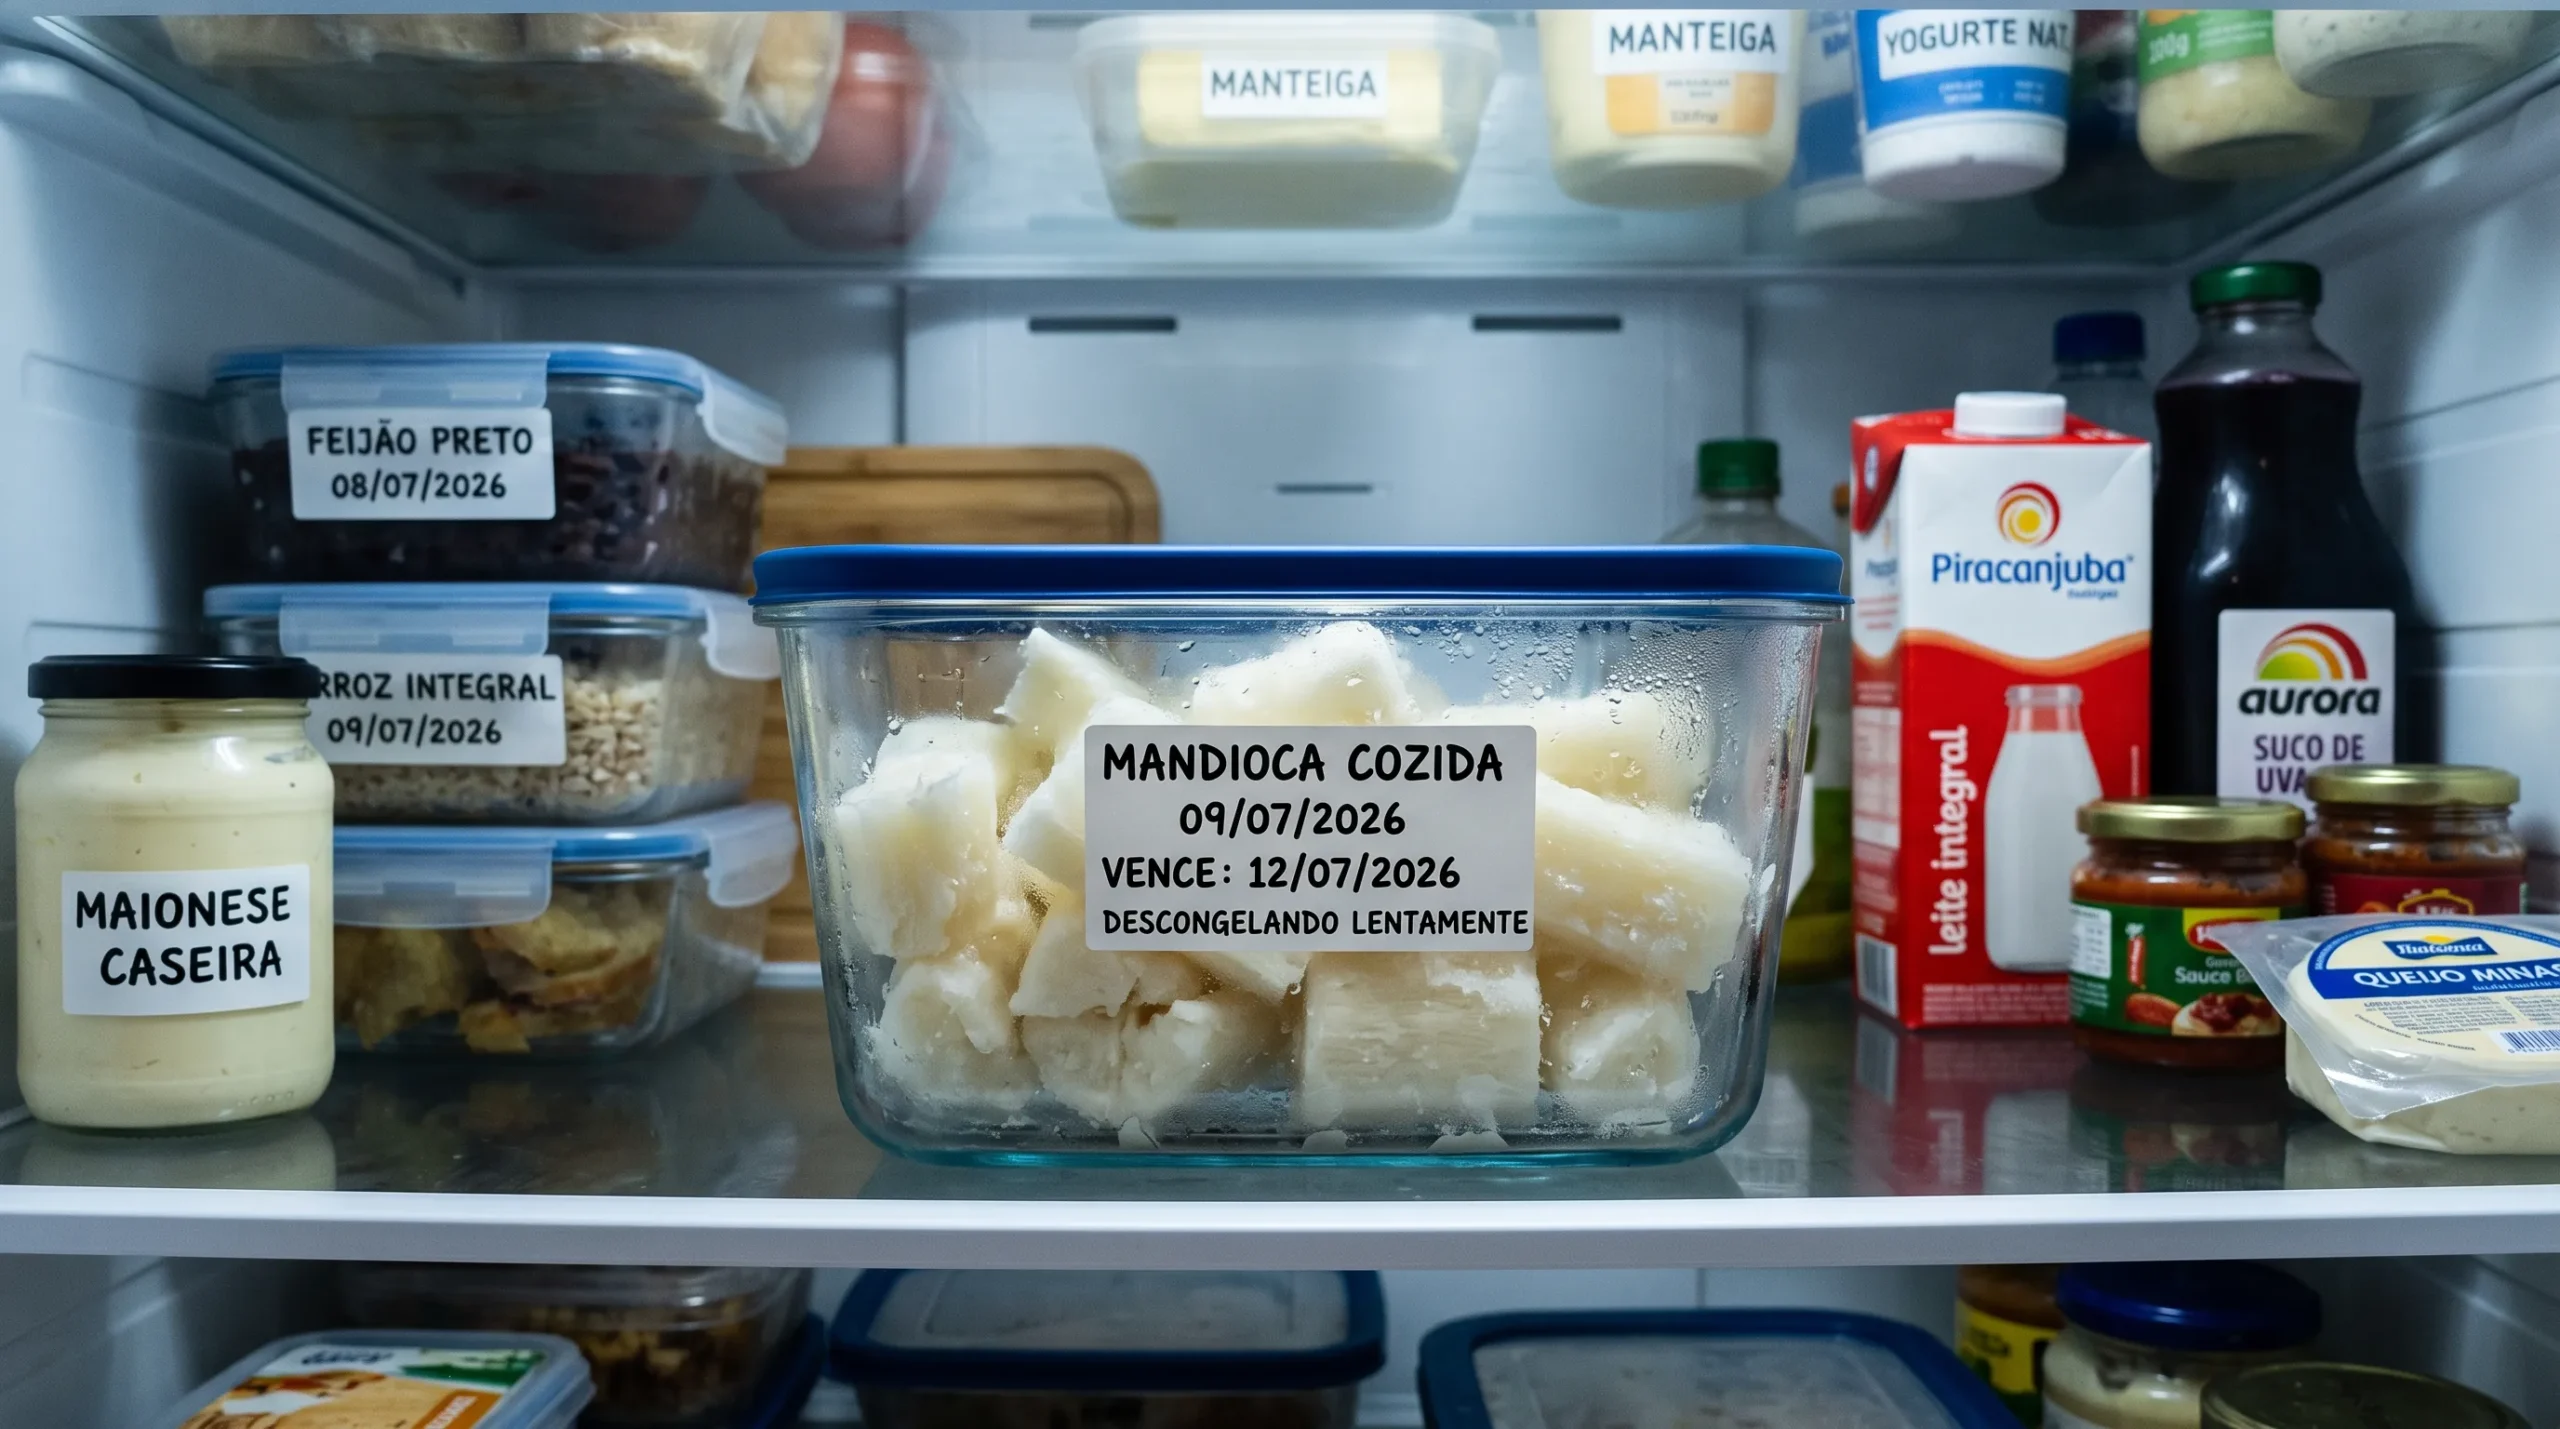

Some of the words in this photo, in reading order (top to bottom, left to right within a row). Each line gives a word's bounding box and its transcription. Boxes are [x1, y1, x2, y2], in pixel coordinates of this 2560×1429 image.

[1610, 21, 1778, 55] MANTEIGA
[1884, 18, 2017, 56] YOGURTE
[1211, 69, 1377, 98] MANTEIGA
[307, 418, 417, 455] FEIJÃO
[431, 426, 533, 455] PRETO
[330, 468, 507, 502] 08/07/2026
[1932, 552, 2126, 591] Piracanjuba
[320, 671, 393, 700] RROZ
[406, 672, 556, 702] INTEGRAL
[2238, 687, 2381, 715] aurora
[327, 713, 502, 748] 09/07/2026
[2254, 734, 2324, 761] SUCO
[2332, 734, 2364, 761] DE
[1103, 743, 1326, 781] MANDIOCA
[1347, 743, 1503, 782] COZIDA
[1929, 725, 1978, 869] integral
[1179, 796, 1406, 839] 09/07/2026
[1101, 857, 1232, 888] VENCE:
[1248, 852, 1461, 893] 12/07/2026
[76, 884, 291, 931] MAIONESE
[1103, 910, 1339, 936] DESCONGELANDO
[1352, 910, 1529, 935] LENTAMENTE
[1929, 878, 1968, 955] leite
[100, 939, 282, 987] CASEIRA
[2175, 966, 2231, 985] Sauce
[2353, 969, 2466, 988] QUEIJO
